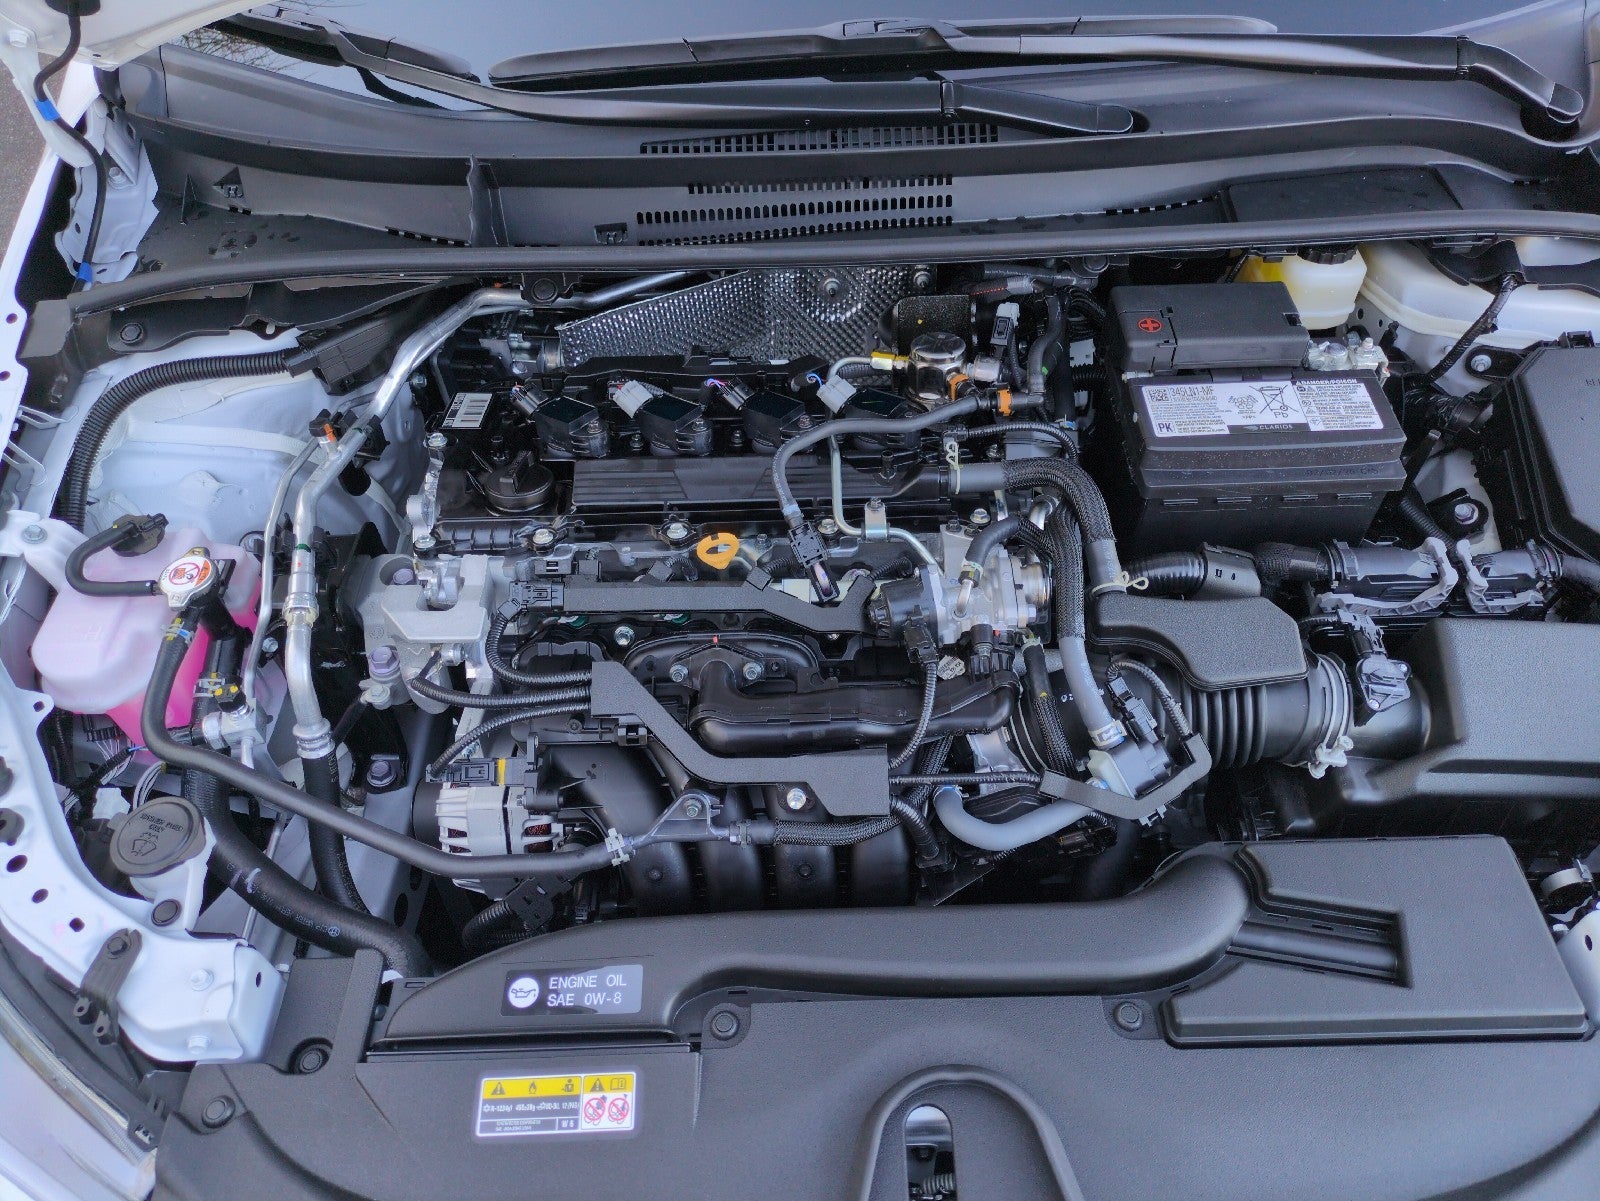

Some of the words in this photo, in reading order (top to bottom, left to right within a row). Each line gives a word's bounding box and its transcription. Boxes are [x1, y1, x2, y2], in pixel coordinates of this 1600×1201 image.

[1273, 411, 1289, 419] Pb
[1157, 422, 1174, 433] PK
[1259, 423, 1293, 431] CLARIOS
[548, 975, 598, 989] ENGINE
[606, 974, 627, 987] OIL
[547, 993, 575, 1007] SAE
[584, 991, 622, 1006] 0W-8
